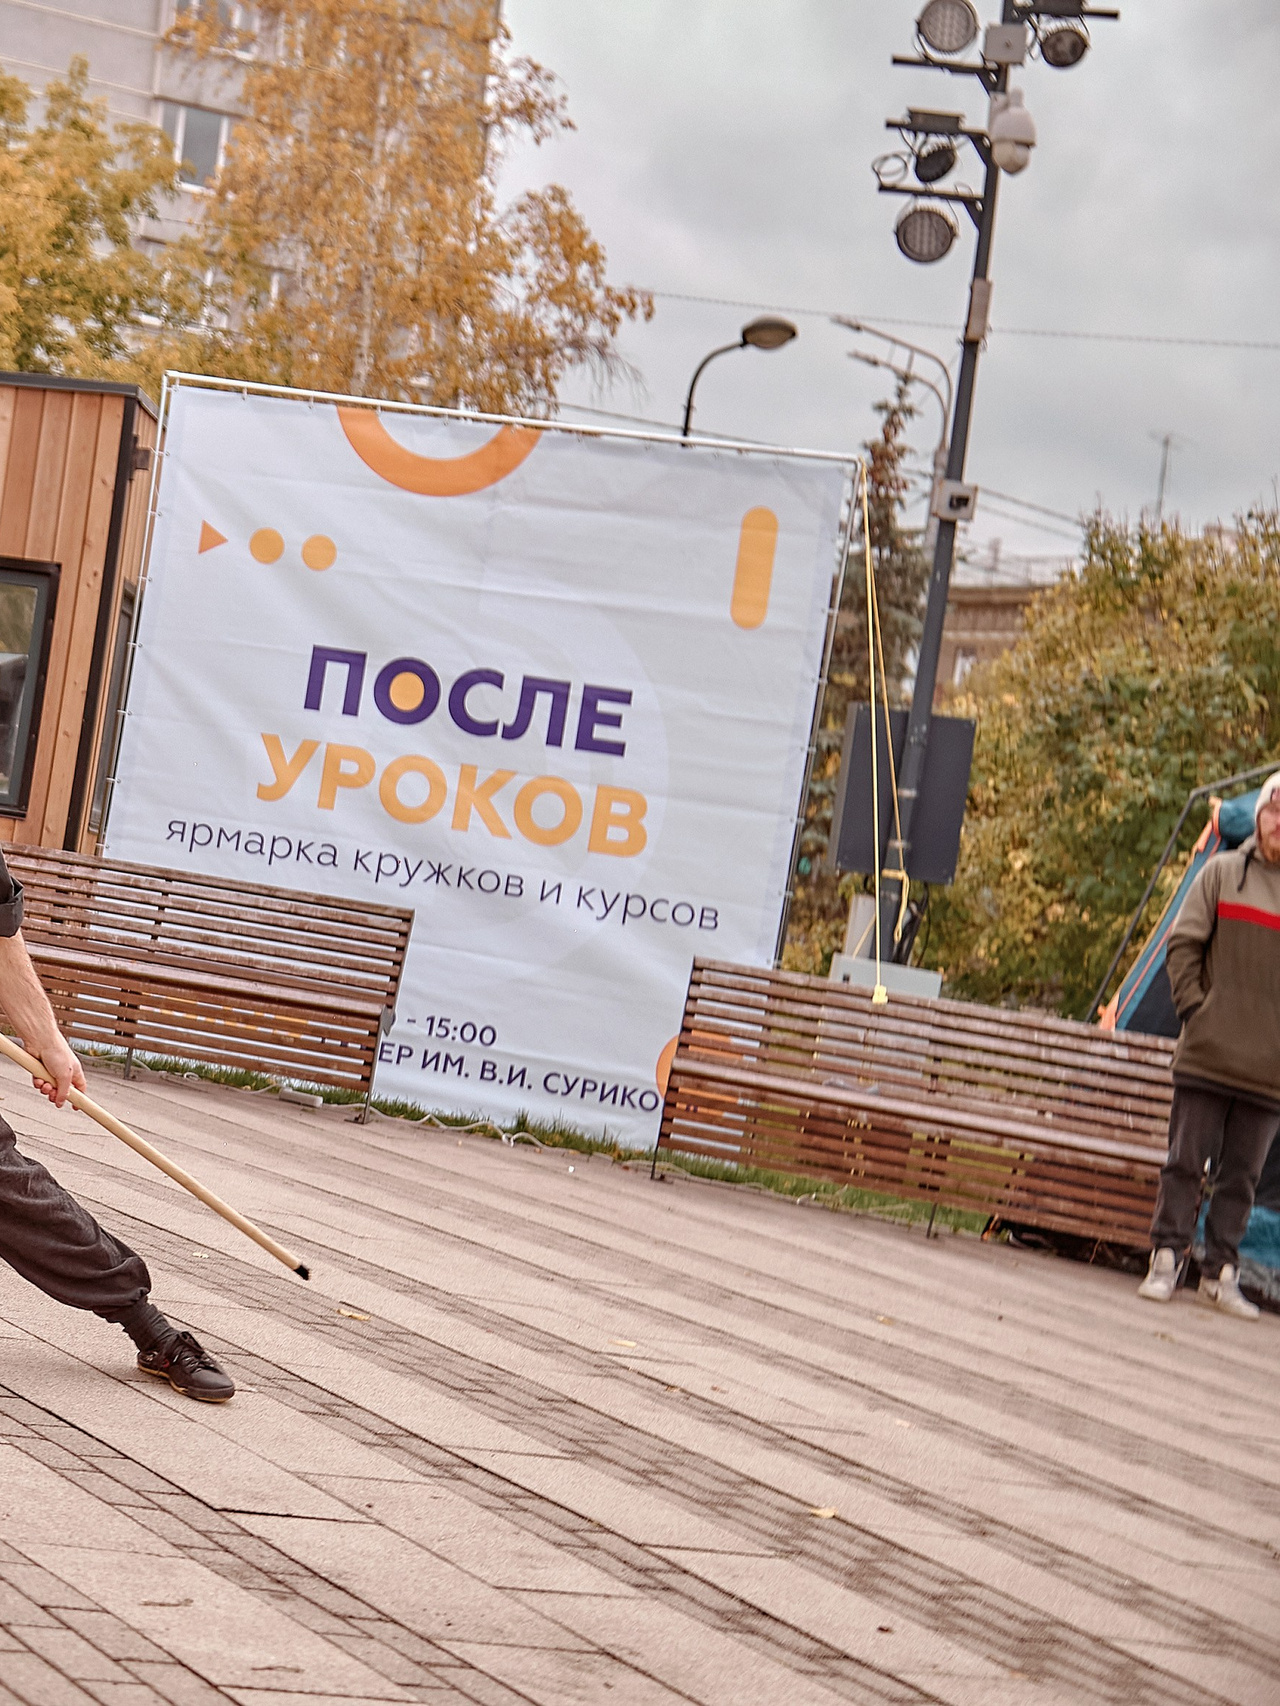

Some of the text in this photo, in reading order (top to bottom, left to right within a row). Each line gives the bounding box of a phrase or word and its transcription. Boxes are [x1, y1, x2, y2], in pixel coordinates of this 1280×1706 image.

[303, 644, 633, 757] ПОСЛЕ
[256, 732, 649, 858] УРОКОВ
[165, 819, 719, 931] ярмарка кружков и курсов
[378, 1041, 660, 1112] ЕР ИМ. В.И. СУРИКО
[426, 1015, 497, 1047] 15:00
